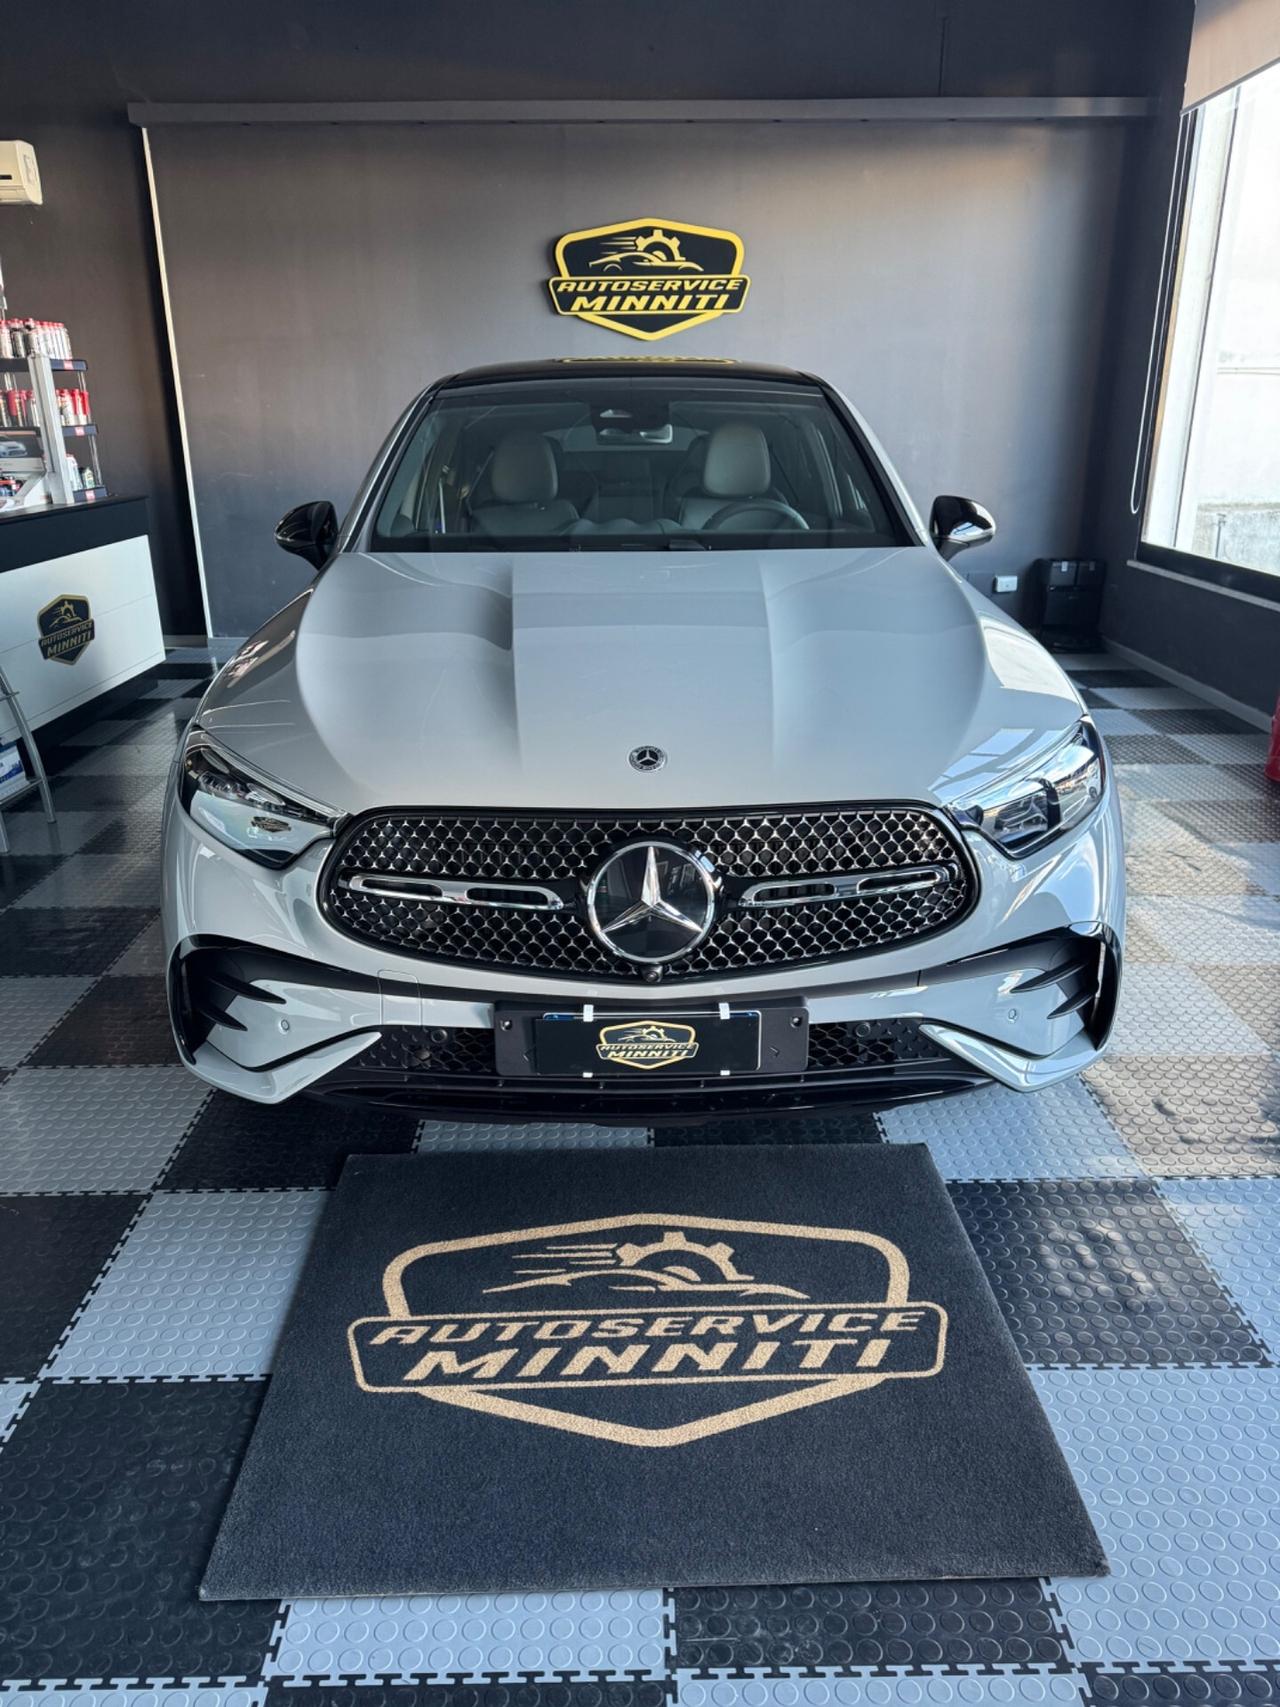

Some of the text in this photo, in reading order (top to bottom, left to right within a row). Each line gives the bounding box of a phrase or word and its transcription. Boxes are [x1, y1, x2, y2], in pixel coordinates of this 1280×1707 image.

[557, 279, 743, 292] AUTOSERVICE
[570, 294, 730, 311] MINNITI
[47, 630, 92, 657] MINNITI
[607, 1050, 688, 1058] MINNITI
[369, 1311, 925, 1345] AUTOSERVICE
[403, 1338, 892, 1381] MINNITI
